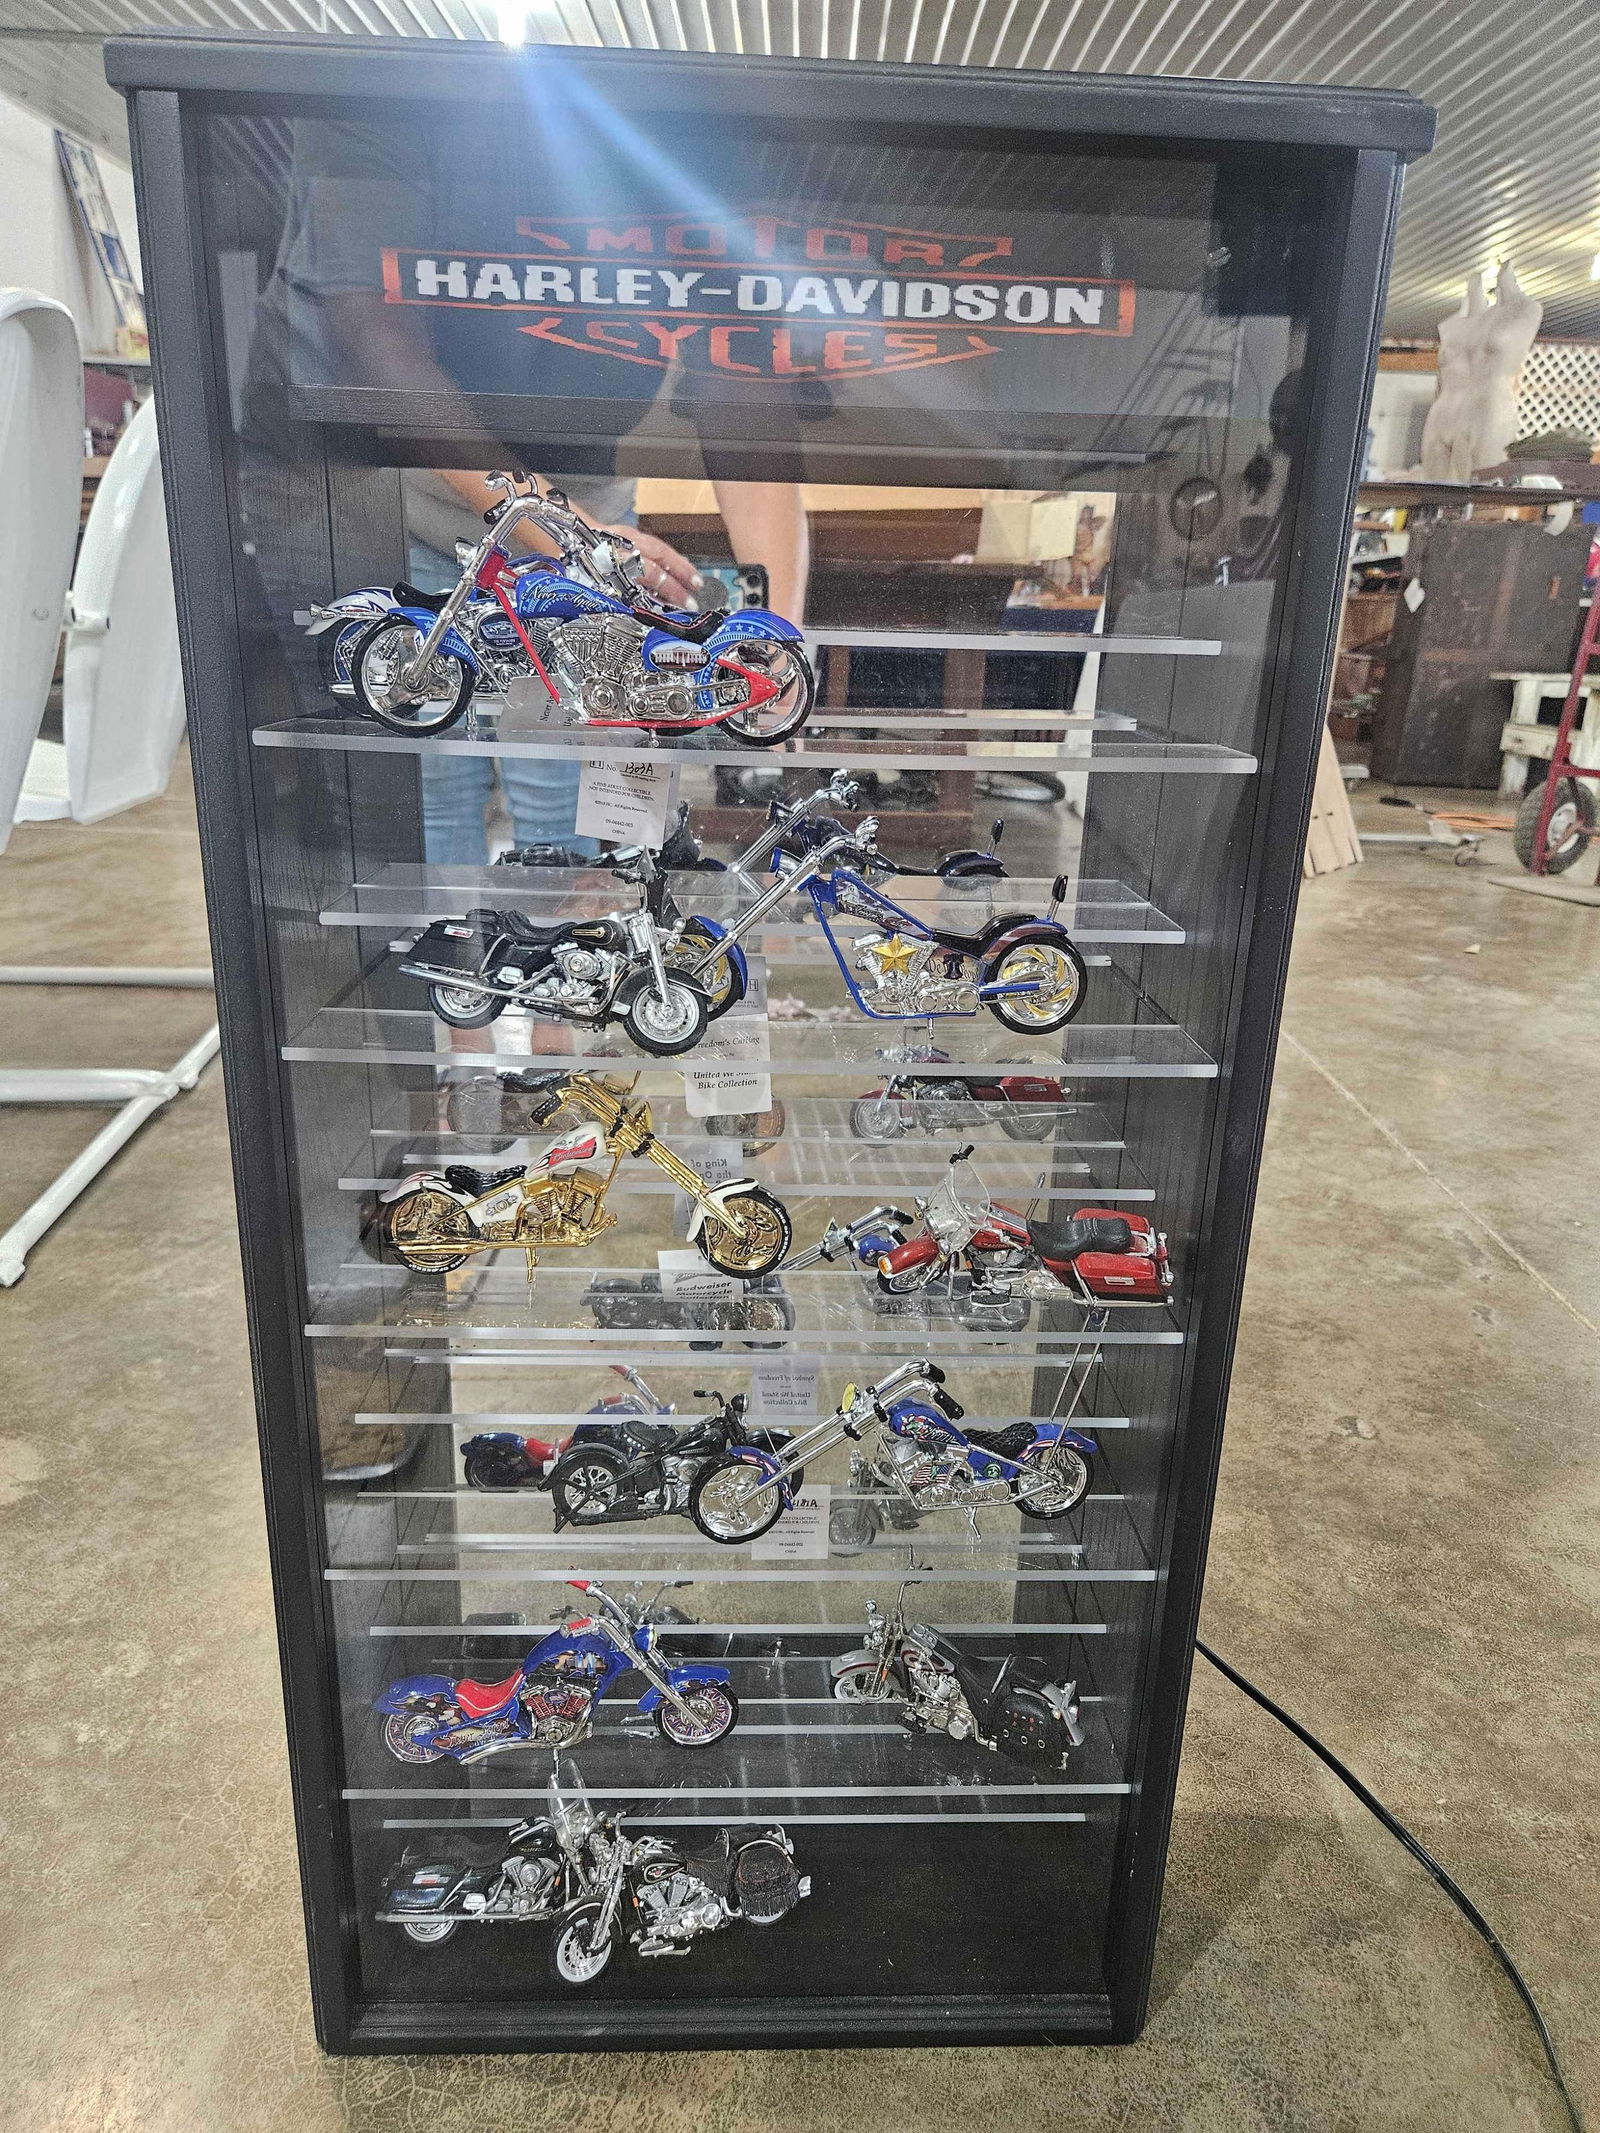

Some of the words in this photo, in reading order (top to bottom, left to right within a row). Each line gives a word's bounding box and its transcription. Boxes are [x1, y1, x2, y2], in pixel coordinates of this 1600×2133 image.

[586, 218, 944, 266] MOTOR
[416, 258, 1102, 324] HARLEY-DAVIDSON
[586, 320, 938, 374] CYCLES
[694, 1038, 731, 1050] reedom's
[697, 1081, 716, 1090] Bike
[717, 1079, 758, 1089] Collection
[676, 1281, 732, 1292] Budweiser
